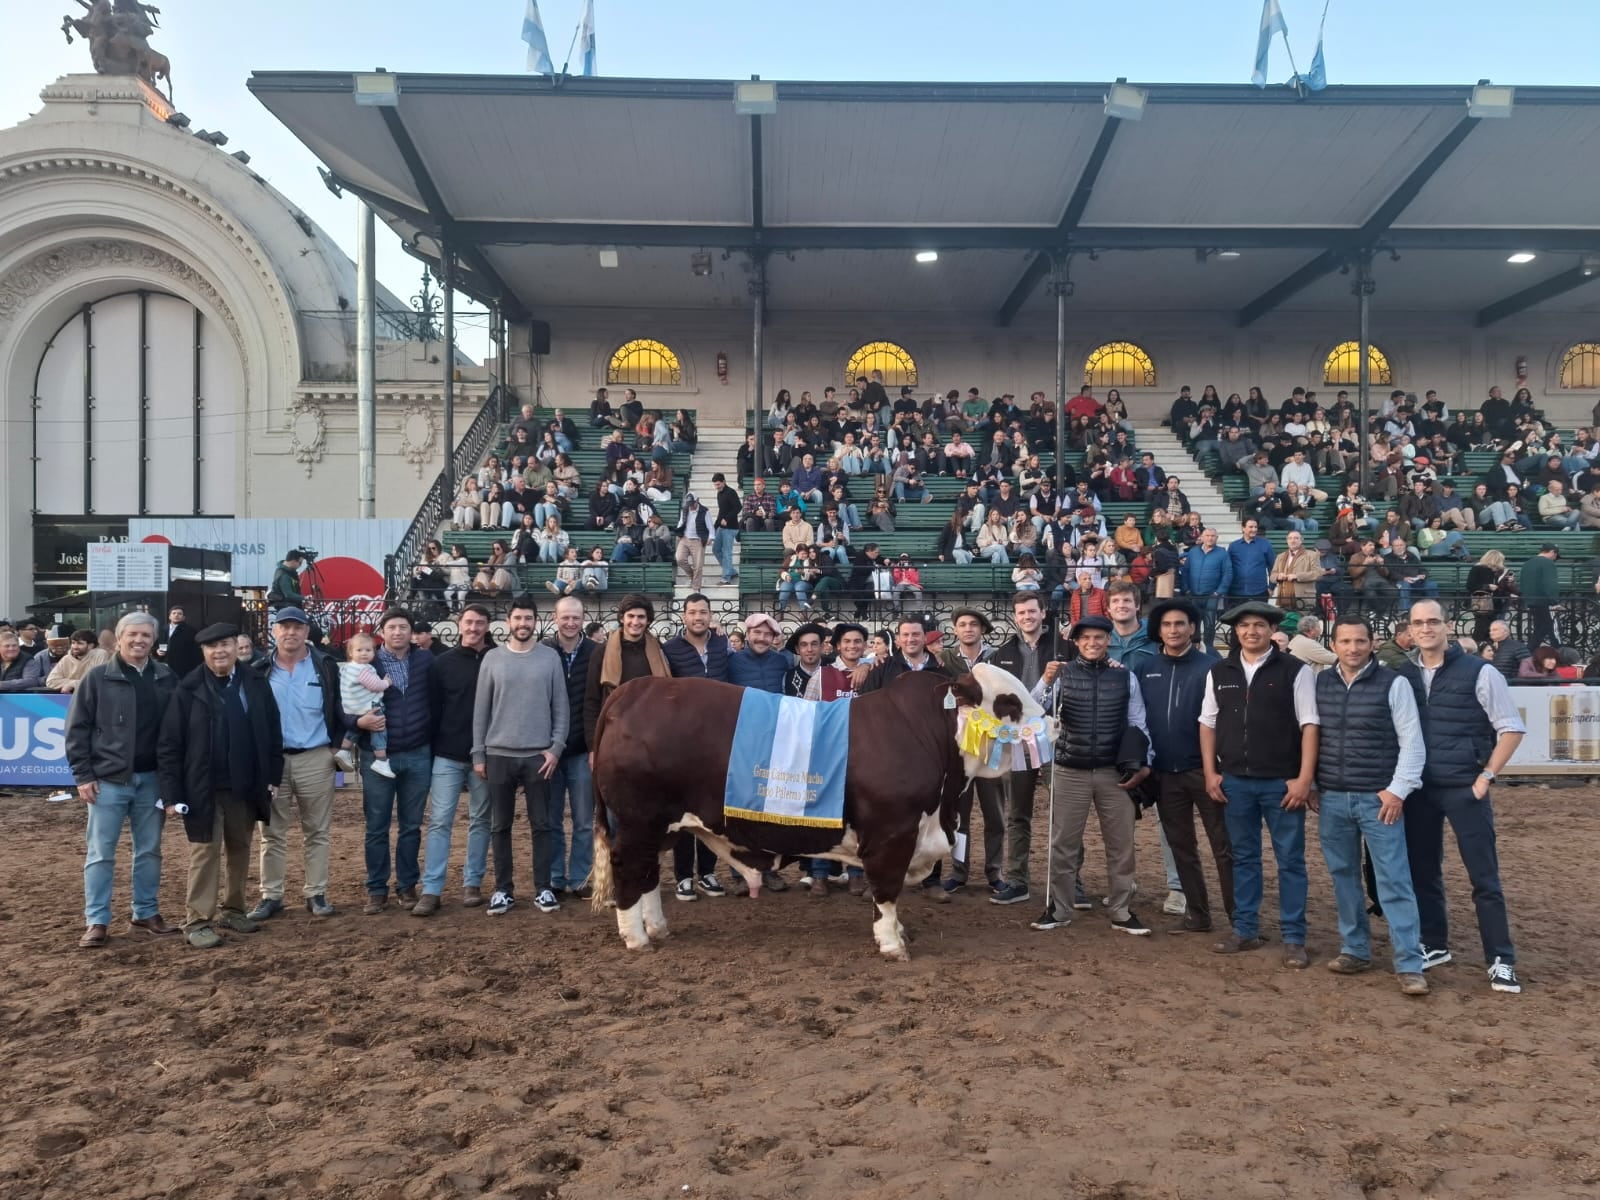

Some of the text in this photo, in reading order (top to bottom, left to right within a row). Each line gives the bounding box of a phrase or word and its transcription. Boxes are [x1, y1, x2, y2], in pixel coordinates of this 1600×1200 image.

[58, 552, 83, 565] José
[20, 765, 69, 774] SEGUROS
[775, 786, 801, 801] Palermo
